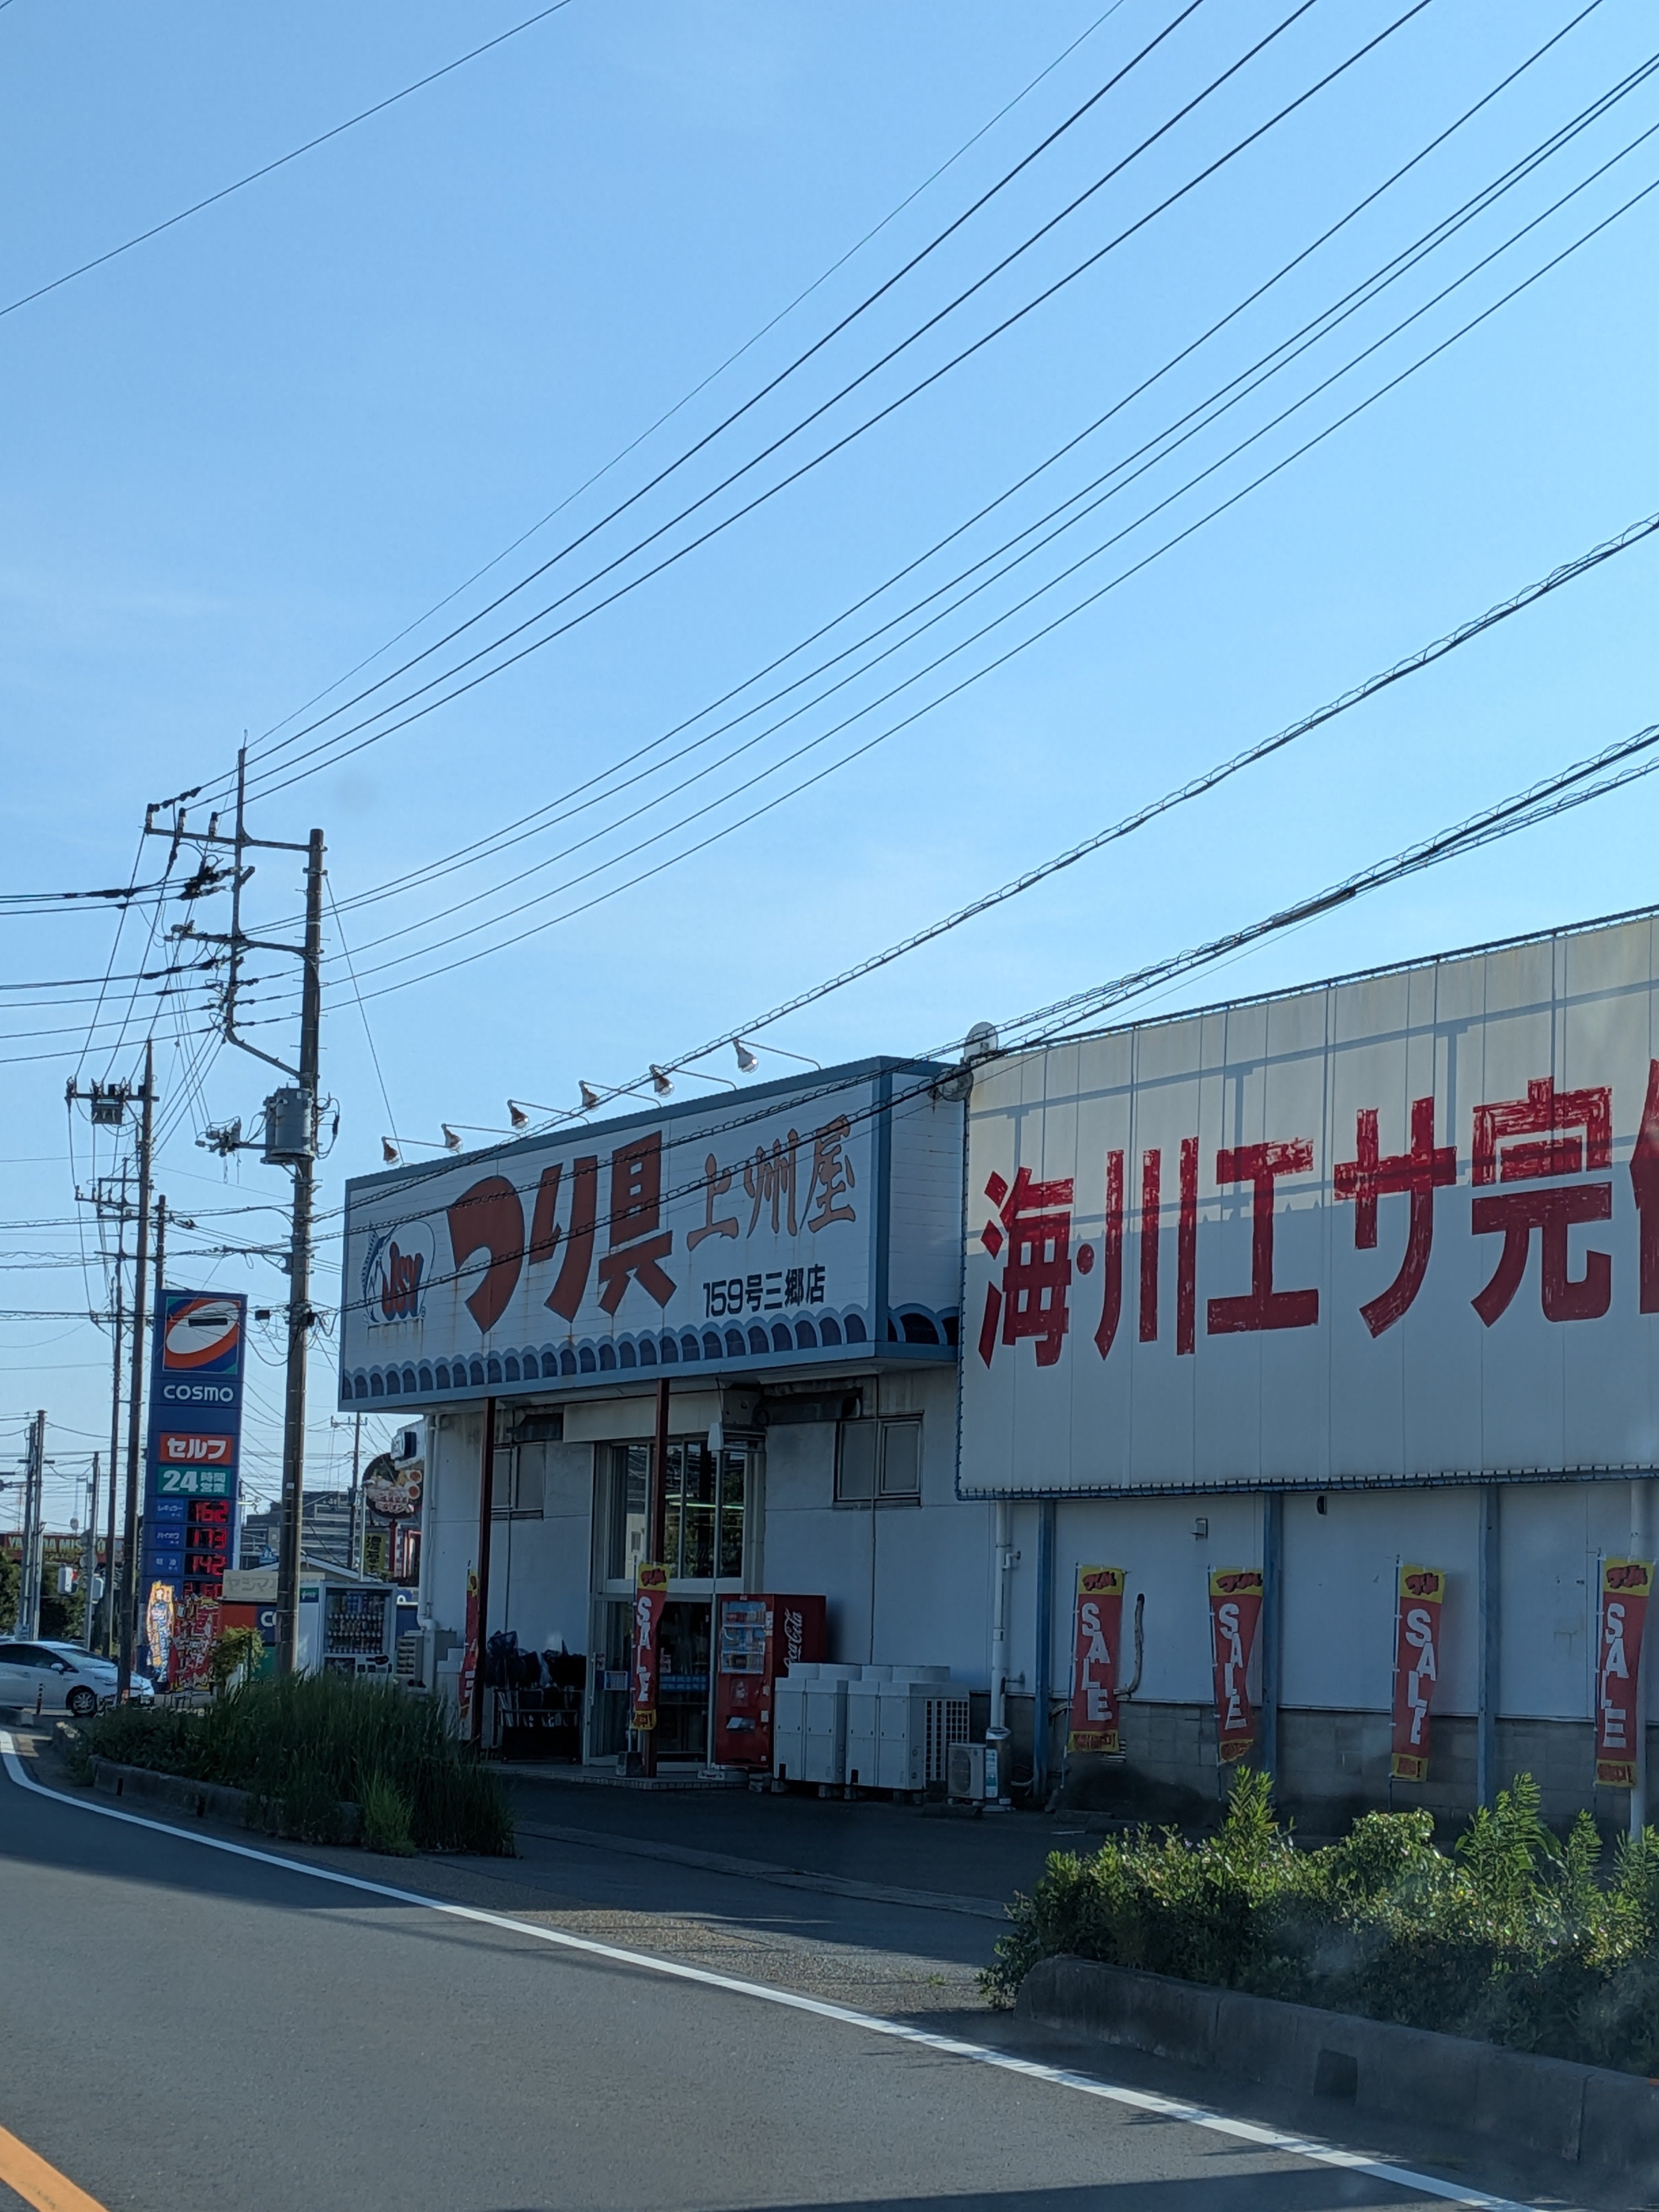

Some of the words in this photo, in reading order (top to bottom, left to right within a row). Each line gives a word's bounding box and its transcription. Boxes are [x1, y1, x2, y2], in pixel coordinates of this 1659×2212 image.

[446, 1130, 677, 1334] つり具
[687, 1114, 855, 1252] 上州屋
[978, 1058, 1659, 1369] 海・川エサ完
[702, 1263, 826, 1318] 159号三郷店
[163, 1385, 234, 1402] COSMO
[167, 1437, 227, 1460] セルフ
[162, 1469, 198, 1493] 24
[1082, 1602, 1113, 1721] SALE
[1219, 1603, 1248, 1730] SALE
[1600, 1603, 1629, 1748] SALE
